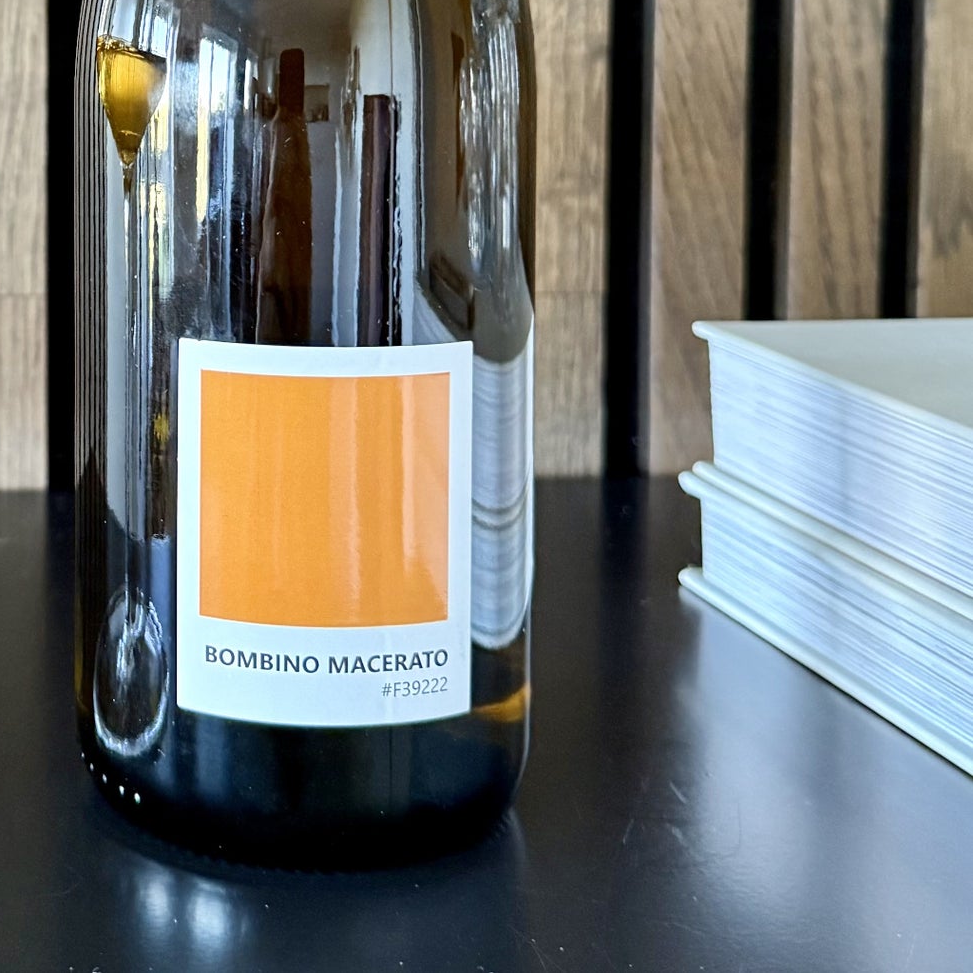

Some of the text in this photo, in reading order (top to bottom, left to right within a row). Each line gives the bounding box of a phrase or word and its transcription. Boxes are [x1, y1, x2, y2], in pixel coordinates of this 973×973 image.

[205, 644, 449, 674] BOMBINO MACERATO
[382, 676, 449, 698] #F39222
